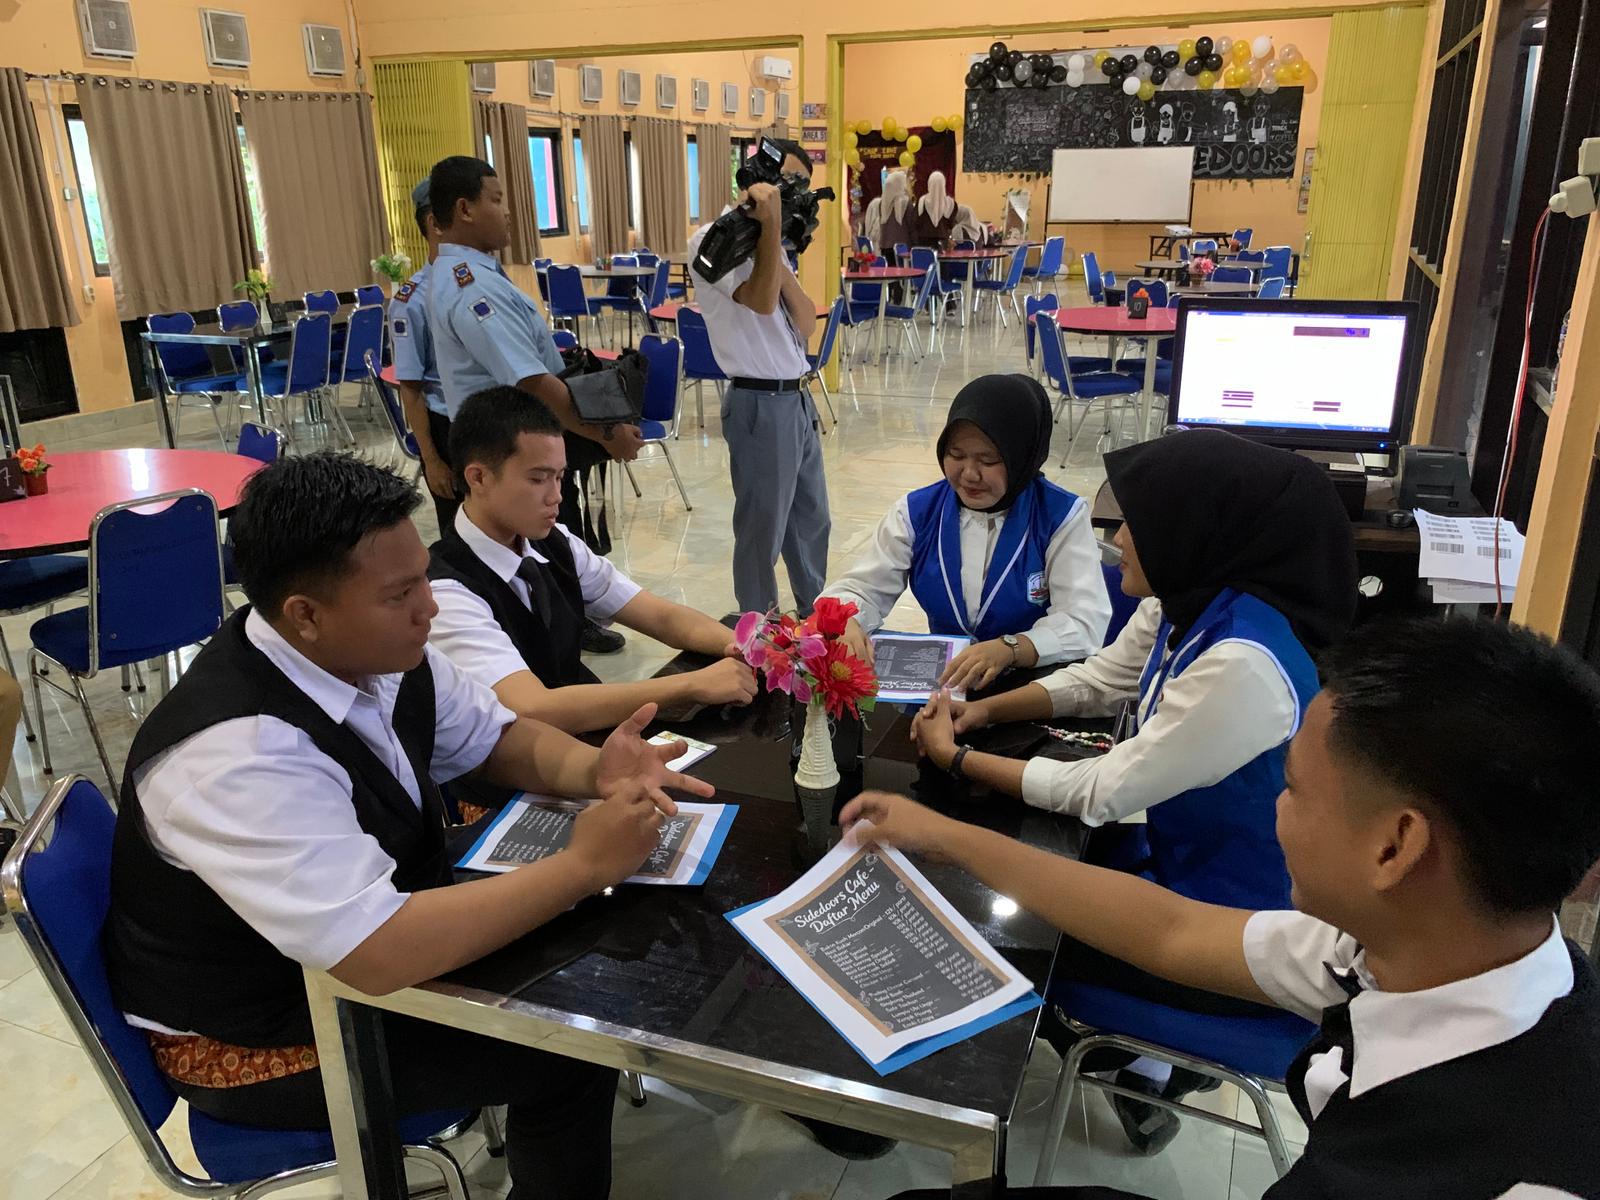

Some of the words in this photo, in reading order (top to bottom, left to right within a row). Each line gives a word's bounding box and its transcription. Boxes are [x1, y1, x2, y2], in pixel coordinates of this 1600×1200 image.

[1133, 302, 1142, 312] 10
[0, 466, 12, 488] 7
[660, 820, 685, 850] Sidedoors
[793, 890, 847, 929] Sidedoors
[844, 869, 869, 894] Cafe
[808, 904, 849, 933] Daftar
[846, 882, 880, 911] Menu
